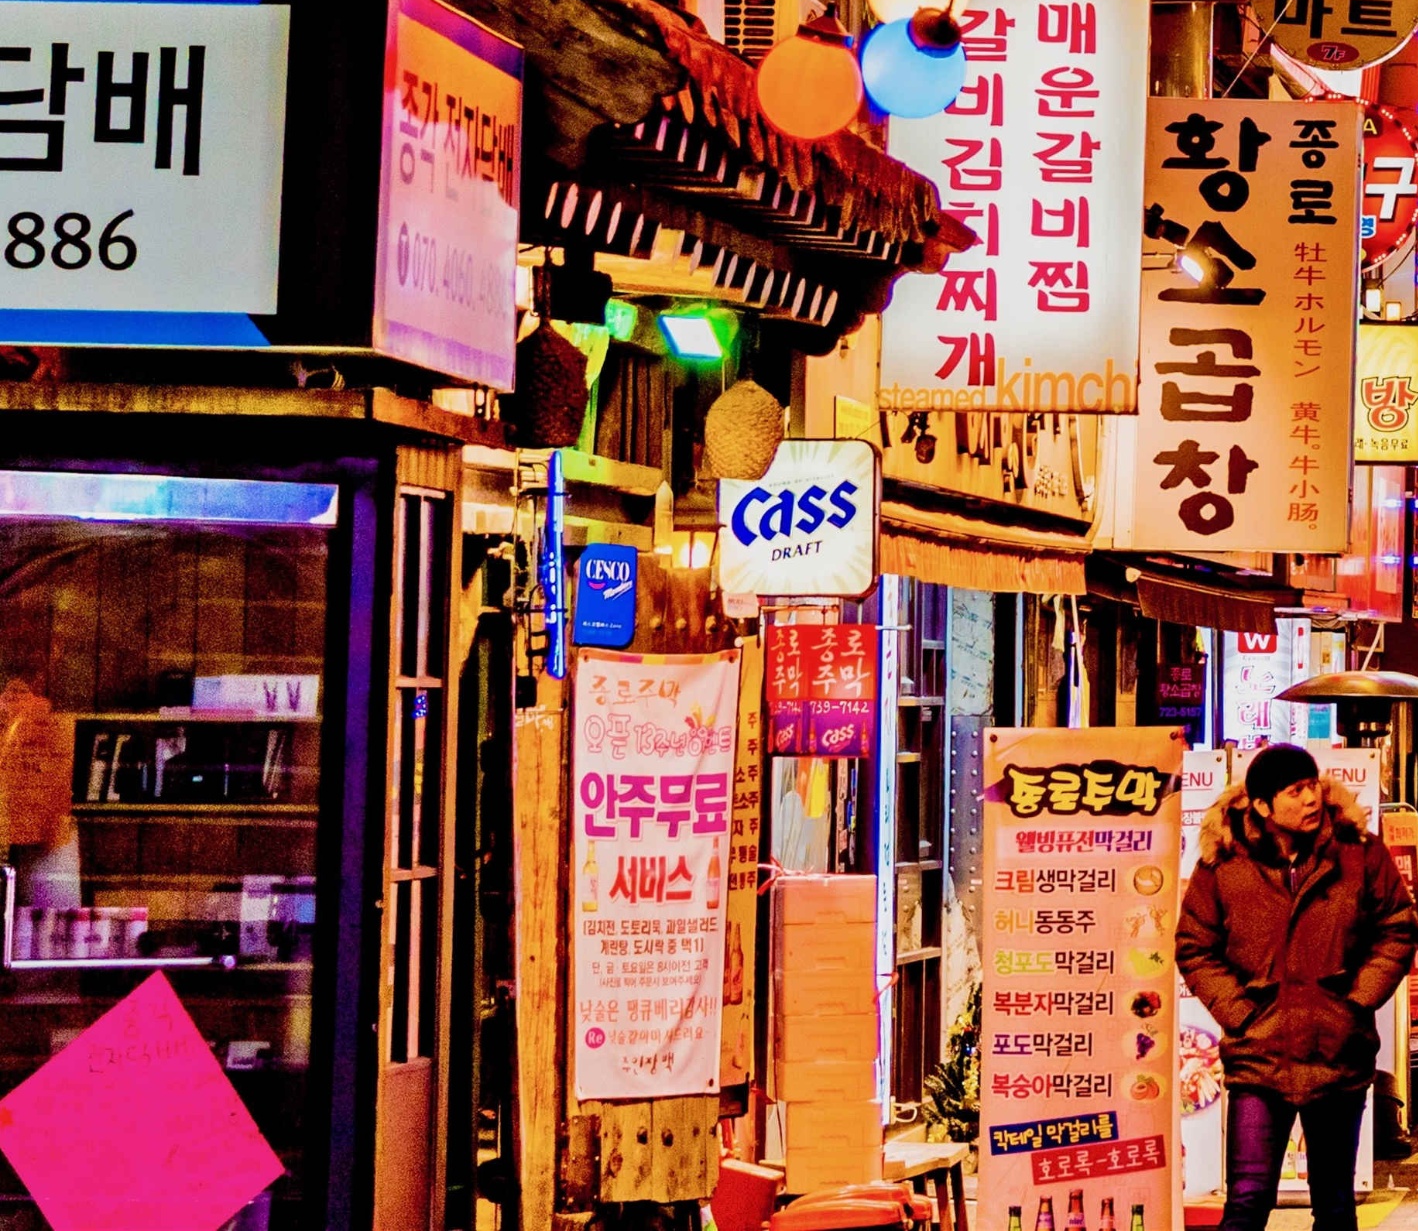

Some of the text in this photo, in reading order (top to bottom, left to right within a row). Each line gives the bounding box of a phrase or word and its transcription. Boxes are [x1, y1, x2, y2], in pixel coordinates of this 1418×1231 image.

[0, 42, 206, 176] 담배
[1027, 1, 1101, 313] 매운갈비찜
[1287, 118, 1340, 225] 종로
[1153, 112, 1272, 534] 황소곱창
[1292, 242, 1328, 379] 牡牛ホルモン
[877, 386, 986, 411] steamed
[732, 480, 858, 546] Cass
[771, 541, 823, 561] DRAFT
[586, 559, 630, 581] CESCO
[811, 628, 866, 662] 종로
[812, 664, 870, 698] 주막
[810, 701, 870, 714] 739-7142
[580, 772, 727, 838] 안주무료
[1015, 829, 1153, 855] 웰빙퓨전막걸리
[609, 855, 693, 904] 서비스
[995, 869, 1117, 894] 크림생막걸리
[995, 909, 1096, 935] 허니동동주
[995, 951, 1115, 977] 청포도막걸리
[993, 991, 1114, 1018] 복분자막걸리
[992, 1032, 1093, 1058] 포도막걸리
[991, 1073, 1113, 1099] 복숭아막걸리
